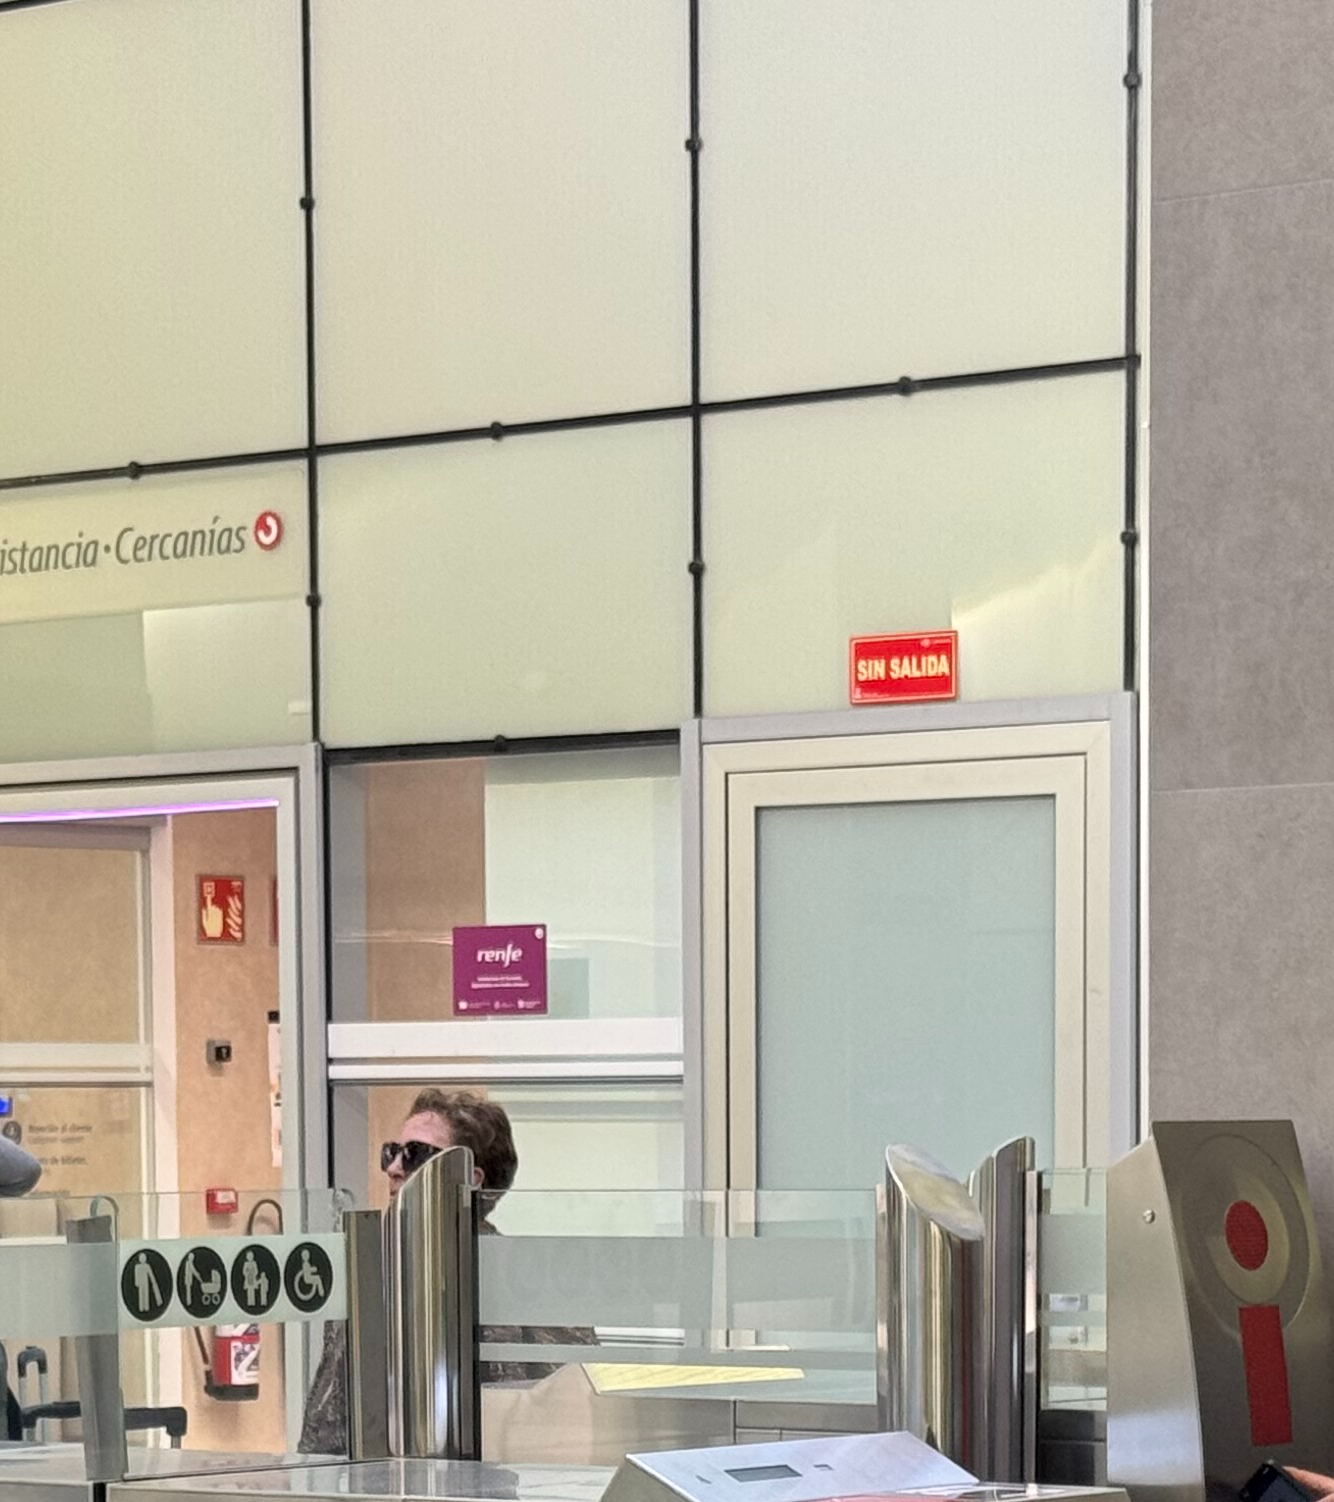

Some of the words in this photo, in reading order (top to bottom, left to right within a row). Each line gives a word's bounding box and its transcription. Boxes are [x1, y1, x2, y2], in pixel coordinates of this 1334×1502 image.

[857, 658, 885, 682] SIN
[890, 654, 950, 680] SALIDA
[477, 943, 522, 968] renfe
